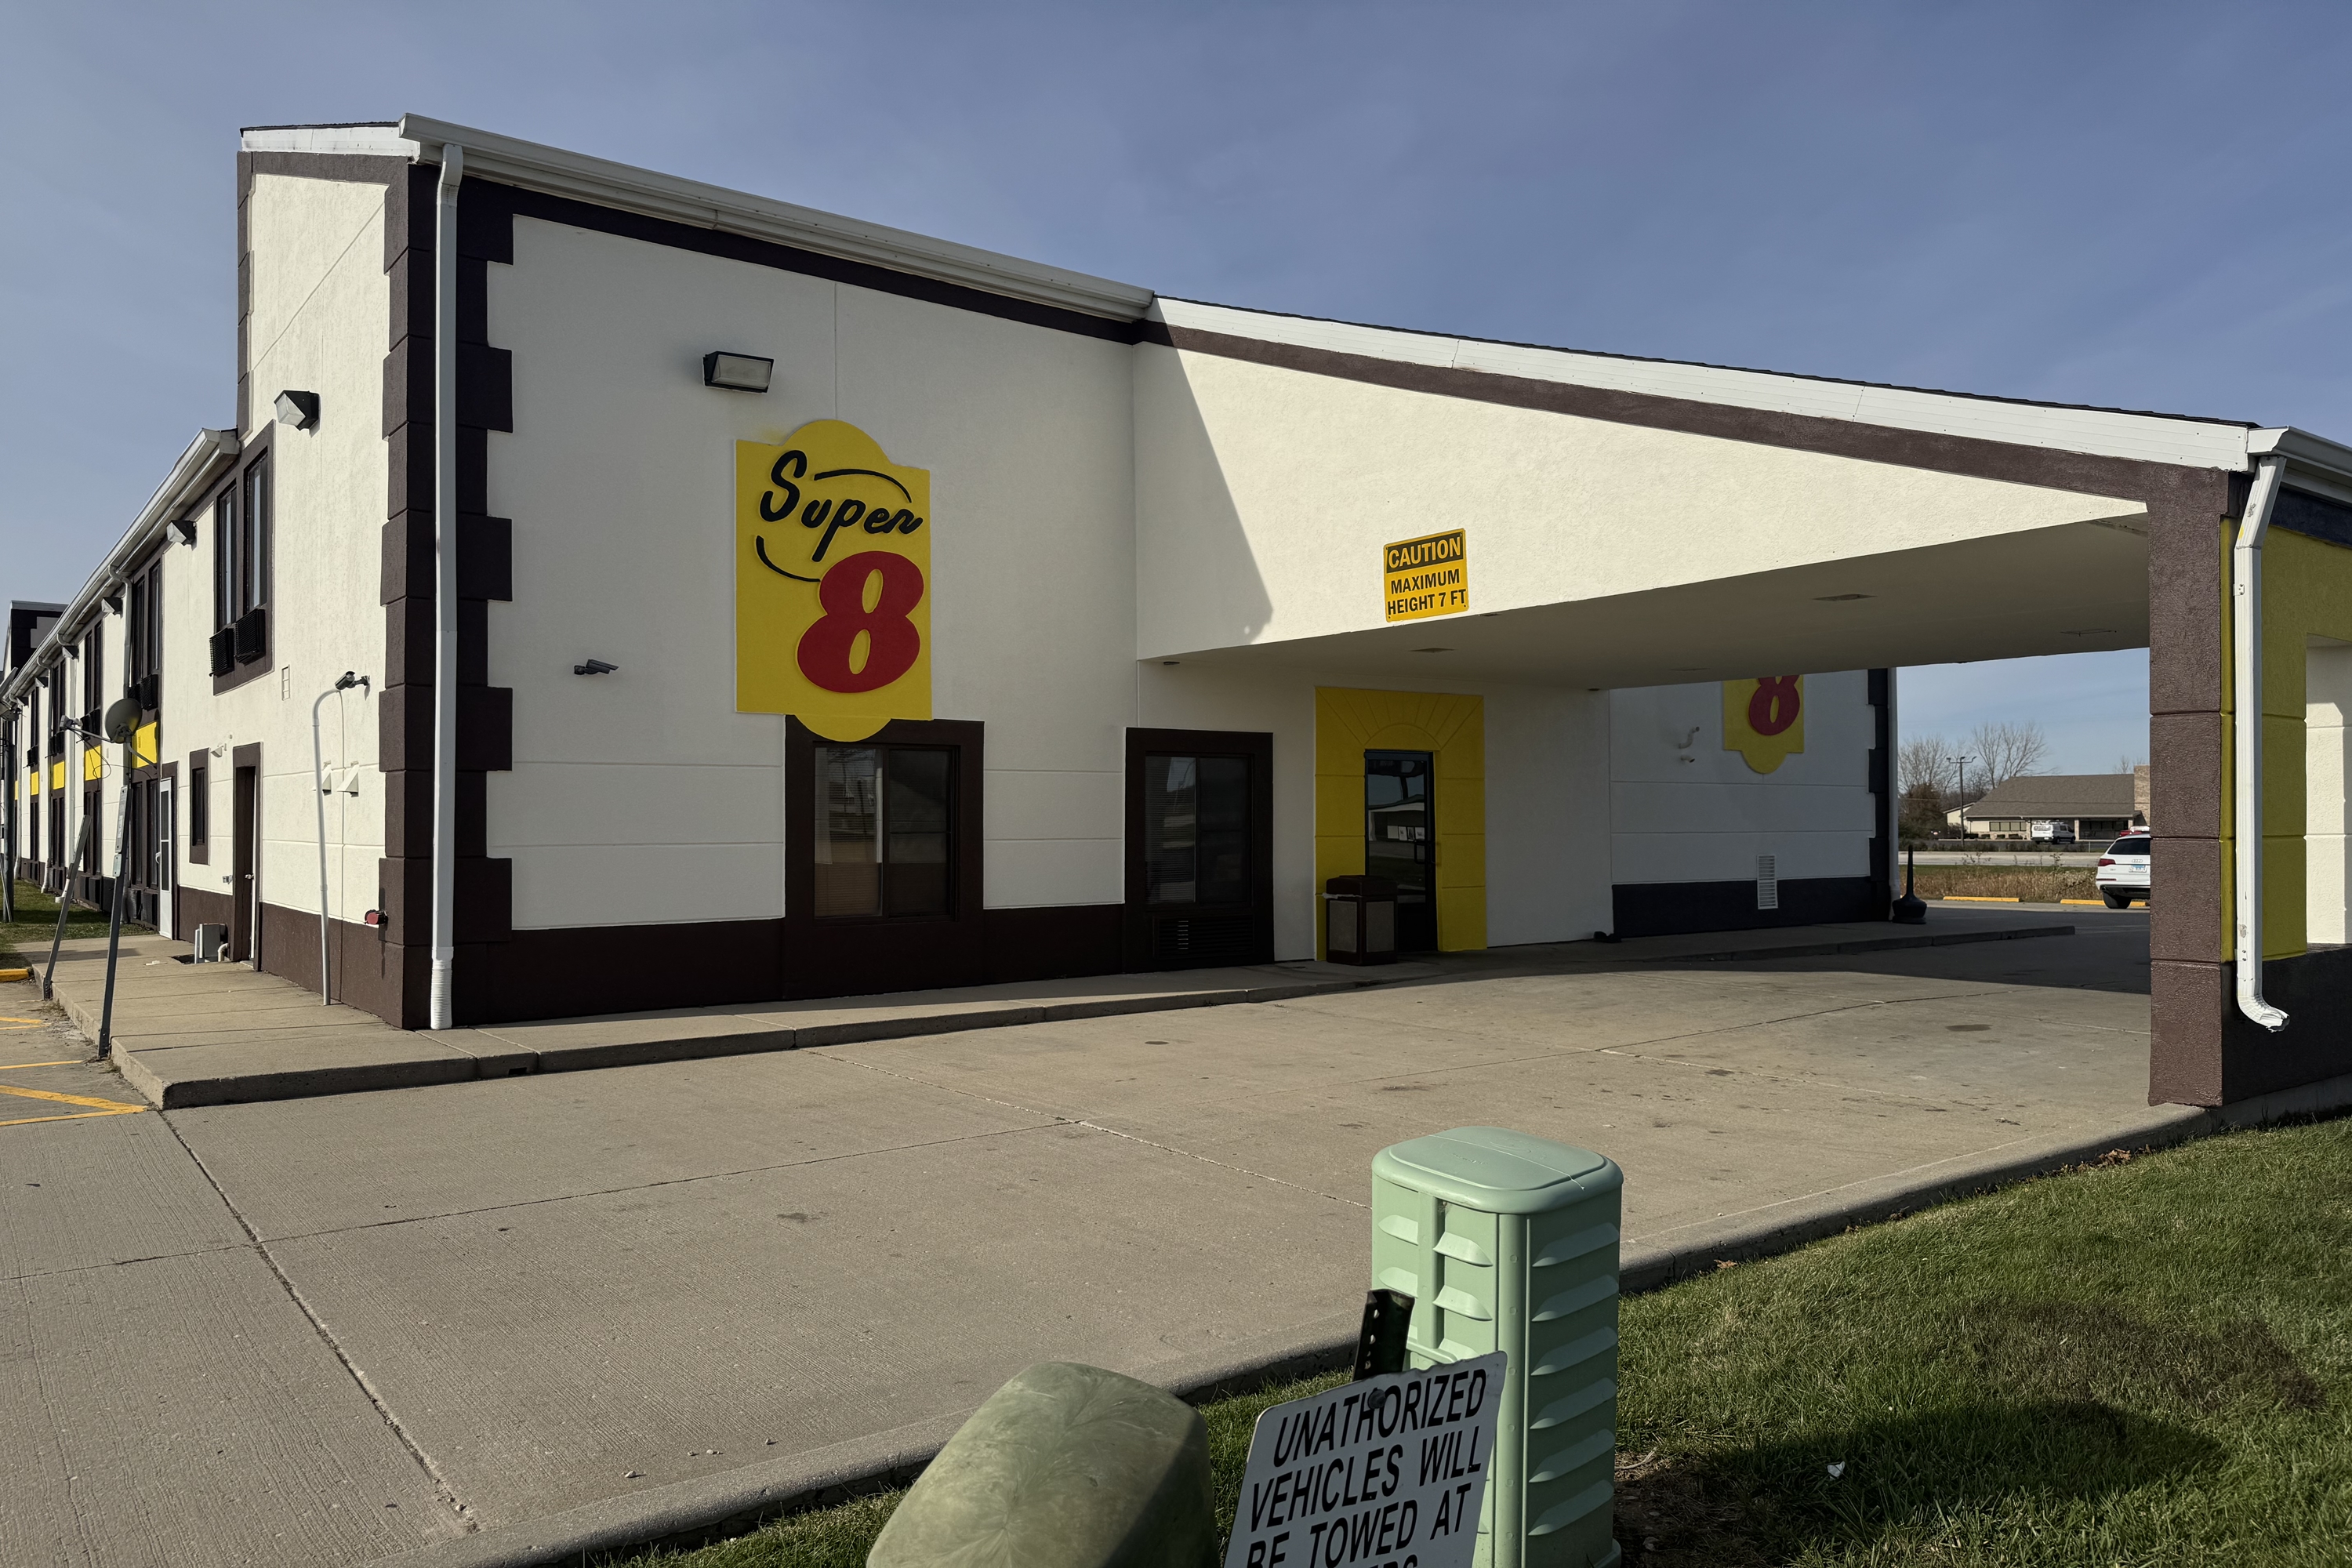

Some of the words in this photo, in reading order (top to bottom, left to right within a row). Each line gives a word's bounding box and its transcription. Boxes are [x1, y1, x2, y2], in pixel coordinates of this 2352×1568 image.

[760, 449, 924, 562] Super
[1388, 536, 1461, 568] CAUTION
[797, 550, 925, 693] 8
[1388, 593, 1436, 615] HEIGHT
[1439, 592, 1446, 607] 7
[1450, 589, 1466, 605] FT
[1391, 568, 1460, 594] MAXIMUM
[1273, 1368, 1486, 1468] UNATHORIZED
[1250, 1444, 1403, 1533] VEHICLES
[1419, 1425, 1482, 1487] WILL
[1309, 1499, 1418, 1568] TOWED
[1429, 1482, 1472, 1541] AT
